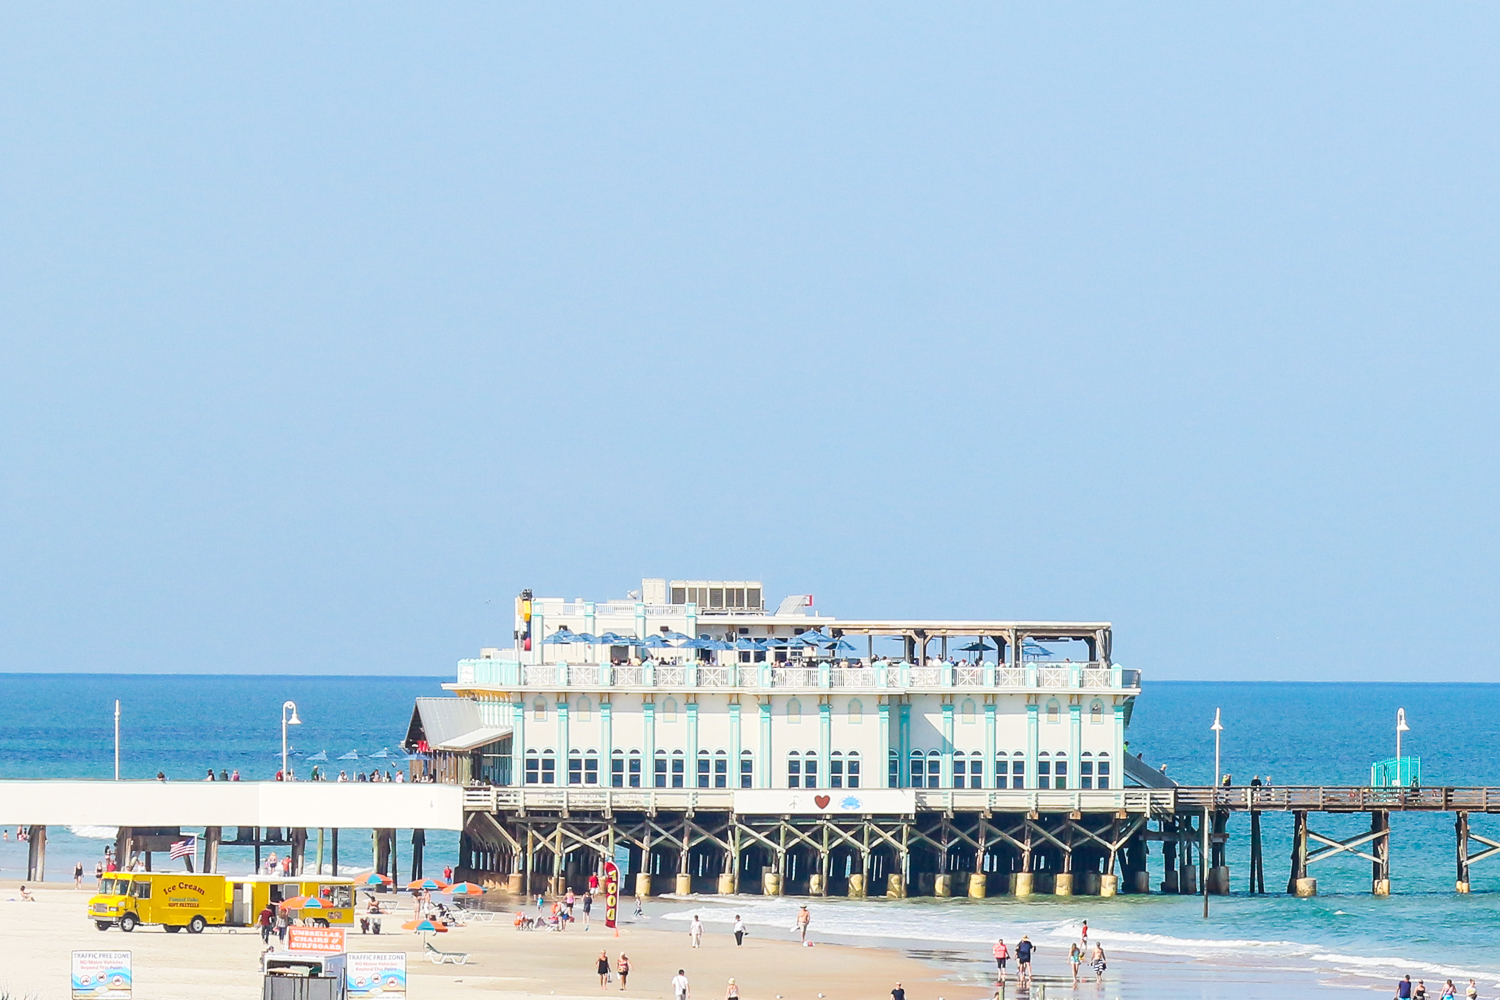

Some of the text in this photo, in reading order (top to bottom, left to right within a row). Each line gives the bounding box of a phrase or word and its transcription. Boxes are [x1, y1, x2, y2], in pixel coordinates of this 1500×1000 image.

[163, 881, 206, 895] Ice Cream
[292, 930, 341, 938] UMBRELLAS,
[291, 942, 341, 950] SURFBOARD
